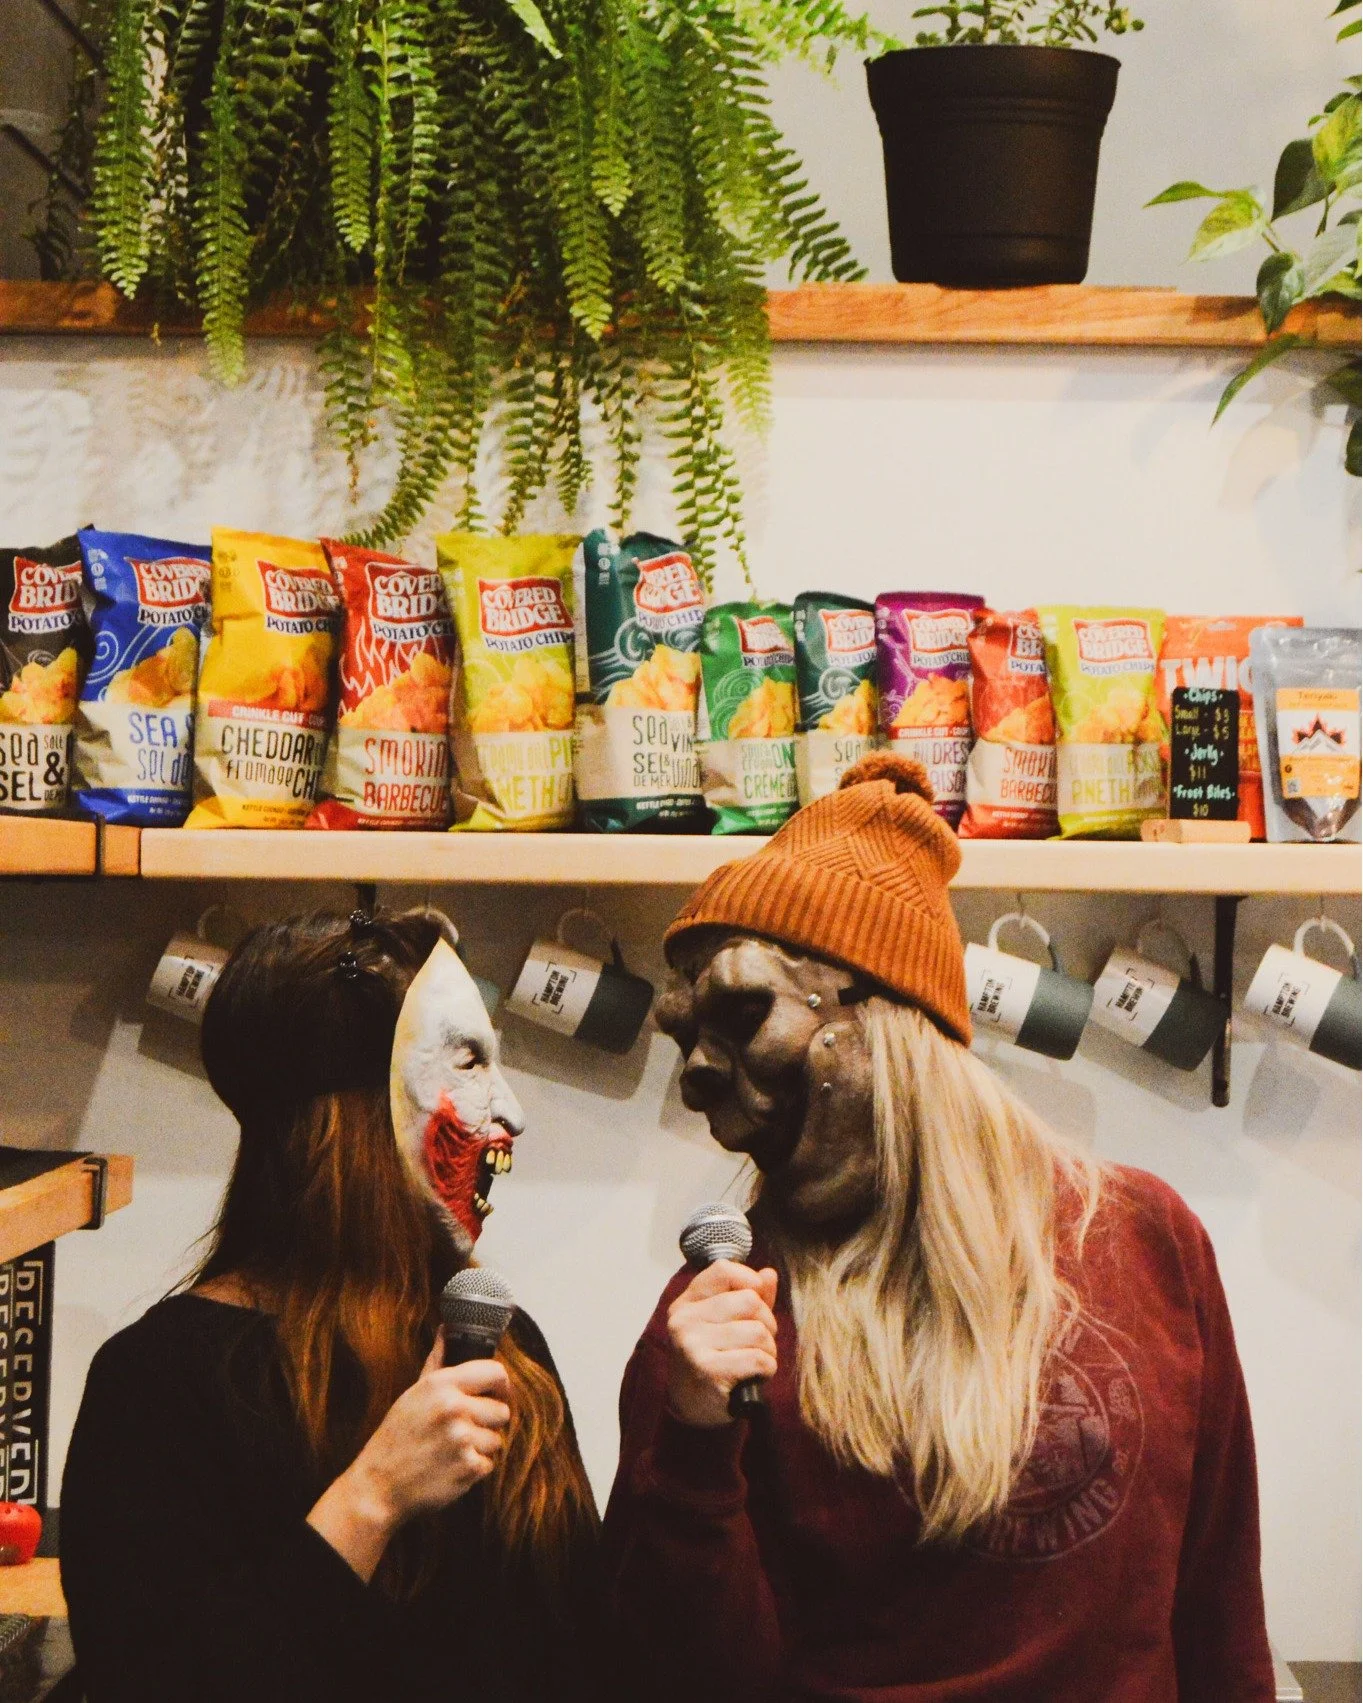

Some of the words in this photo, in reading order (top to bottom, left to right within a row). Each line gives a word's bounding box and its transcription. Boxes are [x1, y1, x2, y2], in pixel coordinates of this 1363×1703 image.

[19, 584, 78, 608] BRID
[374, 573, 444, 596] COVER
[376, 592, 438, 619] BRID
[481, 584, 557, 610] COVERED
[11, 613, 73, 630] POTATO
[140, 608, 193, 625] POTATO
[266, 616, 314, 634] POTATO
[486, 603, 565, 632] BRIDGE
[667, 608, 704, 627] CHIP
[373, 623, 430, 640] POTATO
[485, 632, 533, 652] POTATO
[128, 711, 178, 748] SEA
[221, 724, 316, 767] CHEDDAR
[632, 751, 668, 775] SEL
[364, 780, 448, 813] BARBECUE
